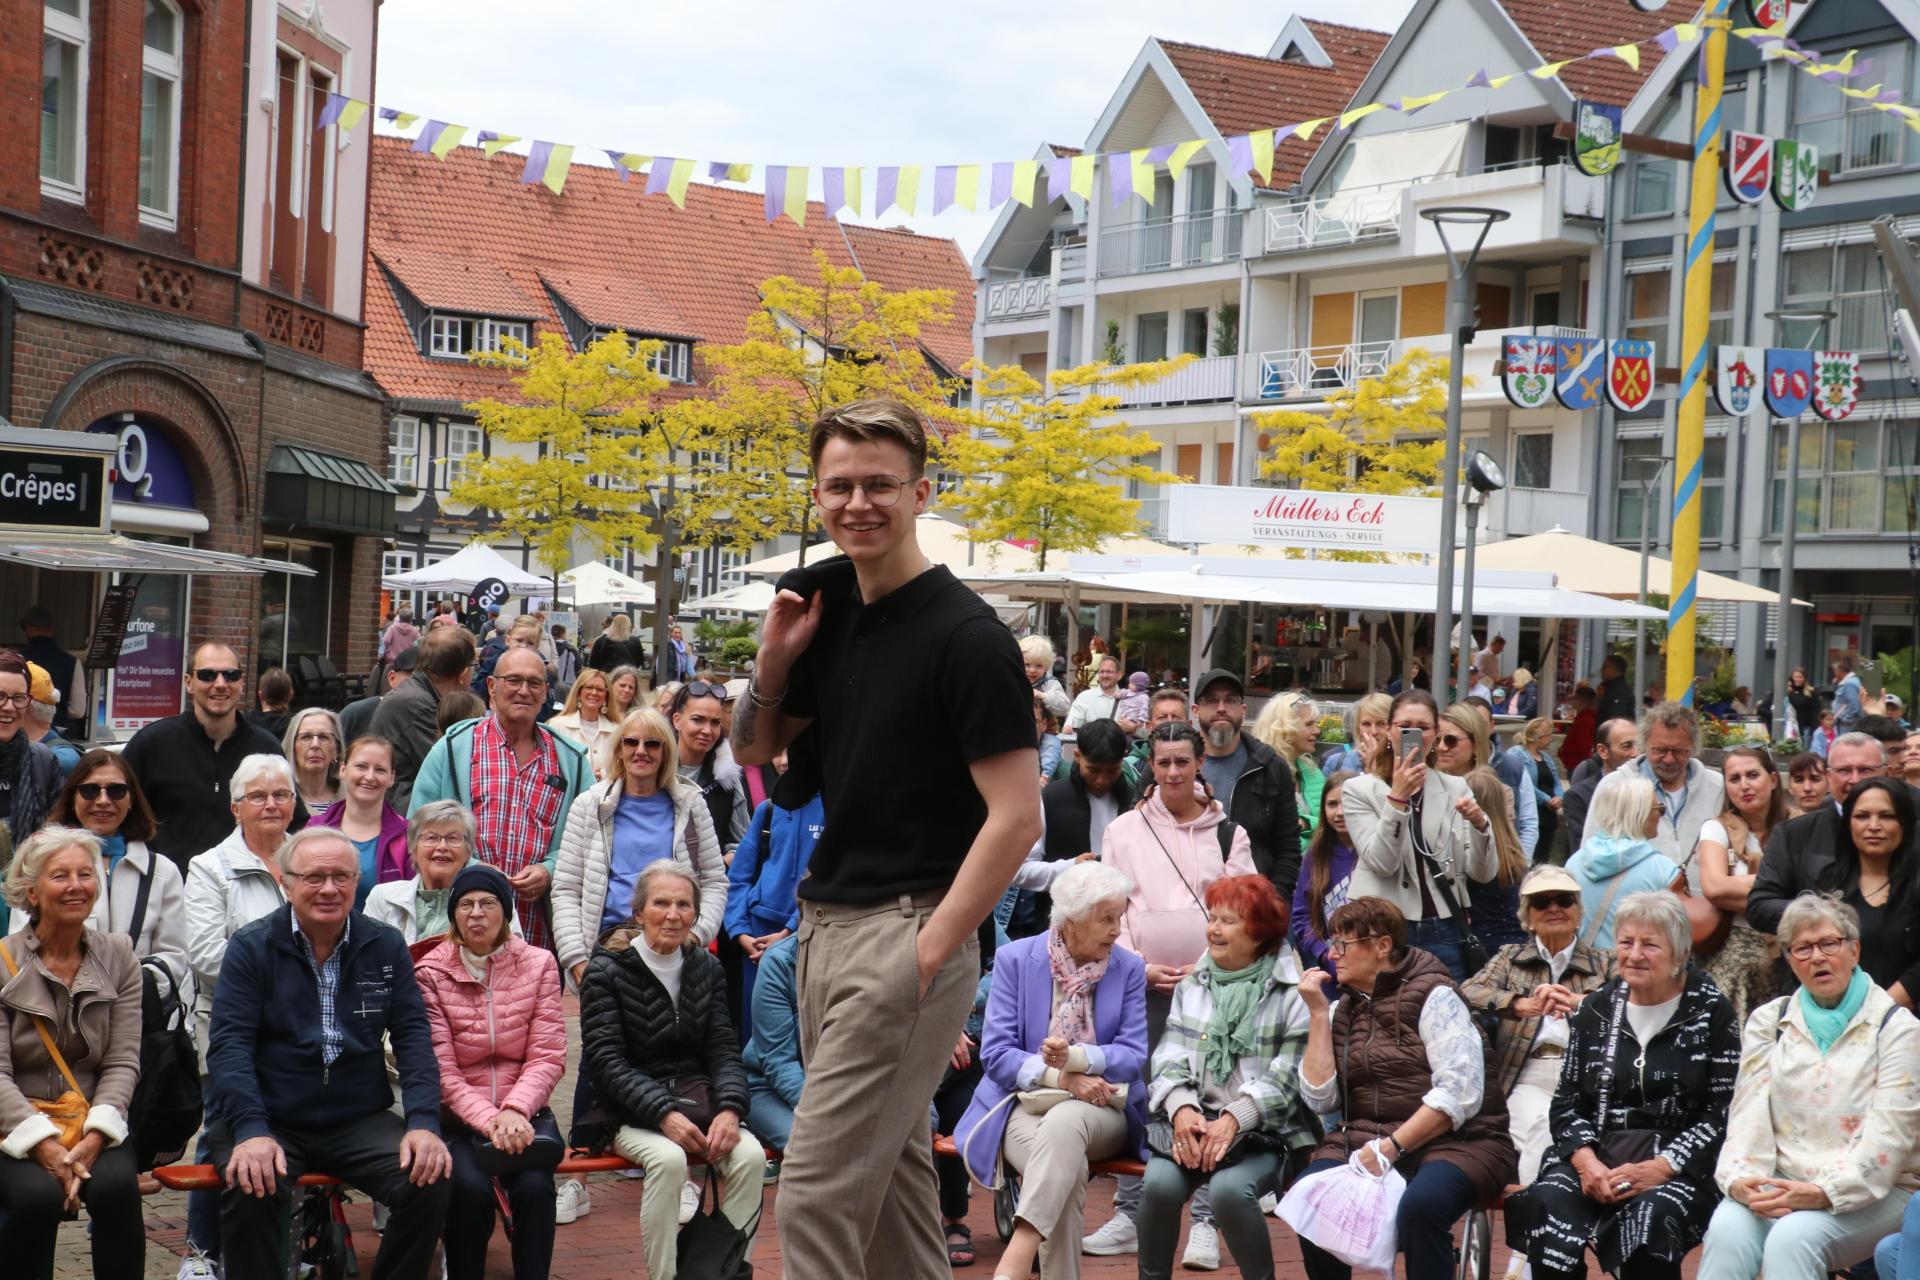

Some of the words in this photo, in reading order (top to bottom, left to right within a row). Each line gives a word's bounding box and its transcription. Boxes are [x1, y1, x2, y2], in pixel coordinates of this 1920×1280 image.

[1, 472, 77, 506] Crêpes
[1253, 495, 1340, 522] Müllers
[1346, 498, 1384, 524] Eck
[1253, 527, 1338, 540] VERANSTALTUNGS
[1346, 532, 1384, 543] SERVICE
[138, 666, 151, 675] Dein
[1612, 998, 1625, 1029] YOURSELF
